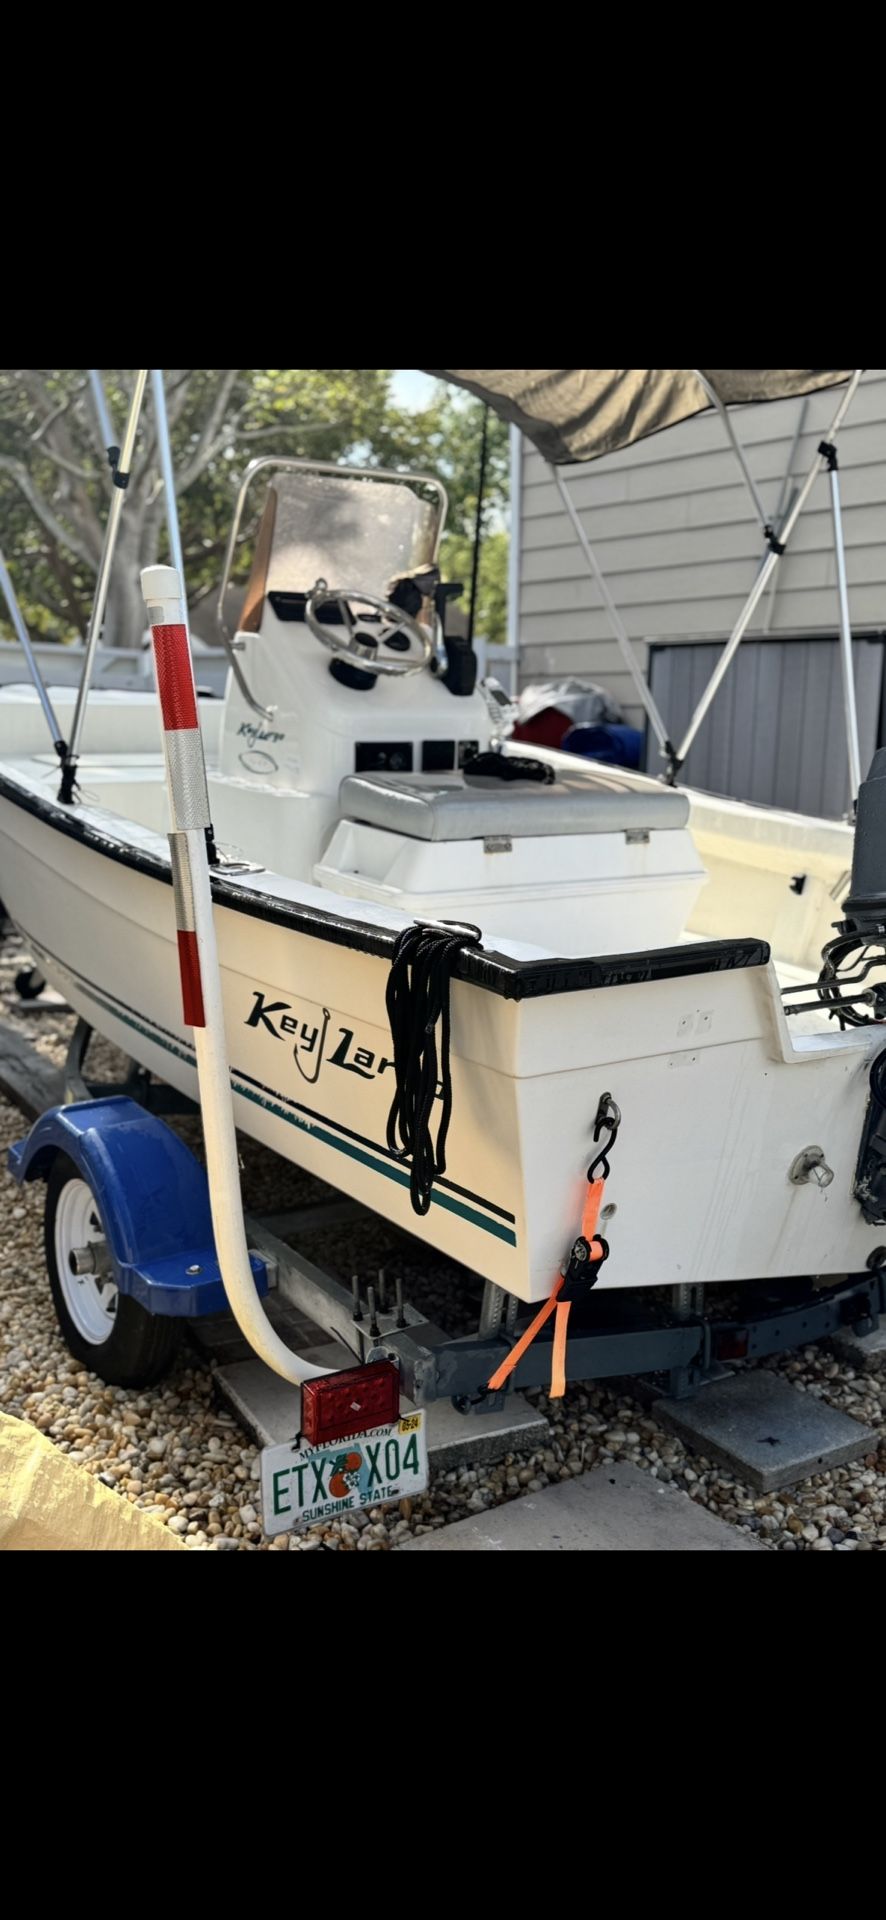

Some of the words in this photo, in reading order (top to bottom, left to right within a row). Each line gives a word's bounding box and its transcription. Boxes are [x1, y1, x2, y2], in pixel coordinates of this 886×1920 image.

[244, 991, 319, 1052] Key
[273, 1458, 328, 1515] ETX
[366, 1433, 419, 1488] X04
[302, 1496, 355, 1522] SUNSHINE
[359, 1486, 393, 1505] STATE
